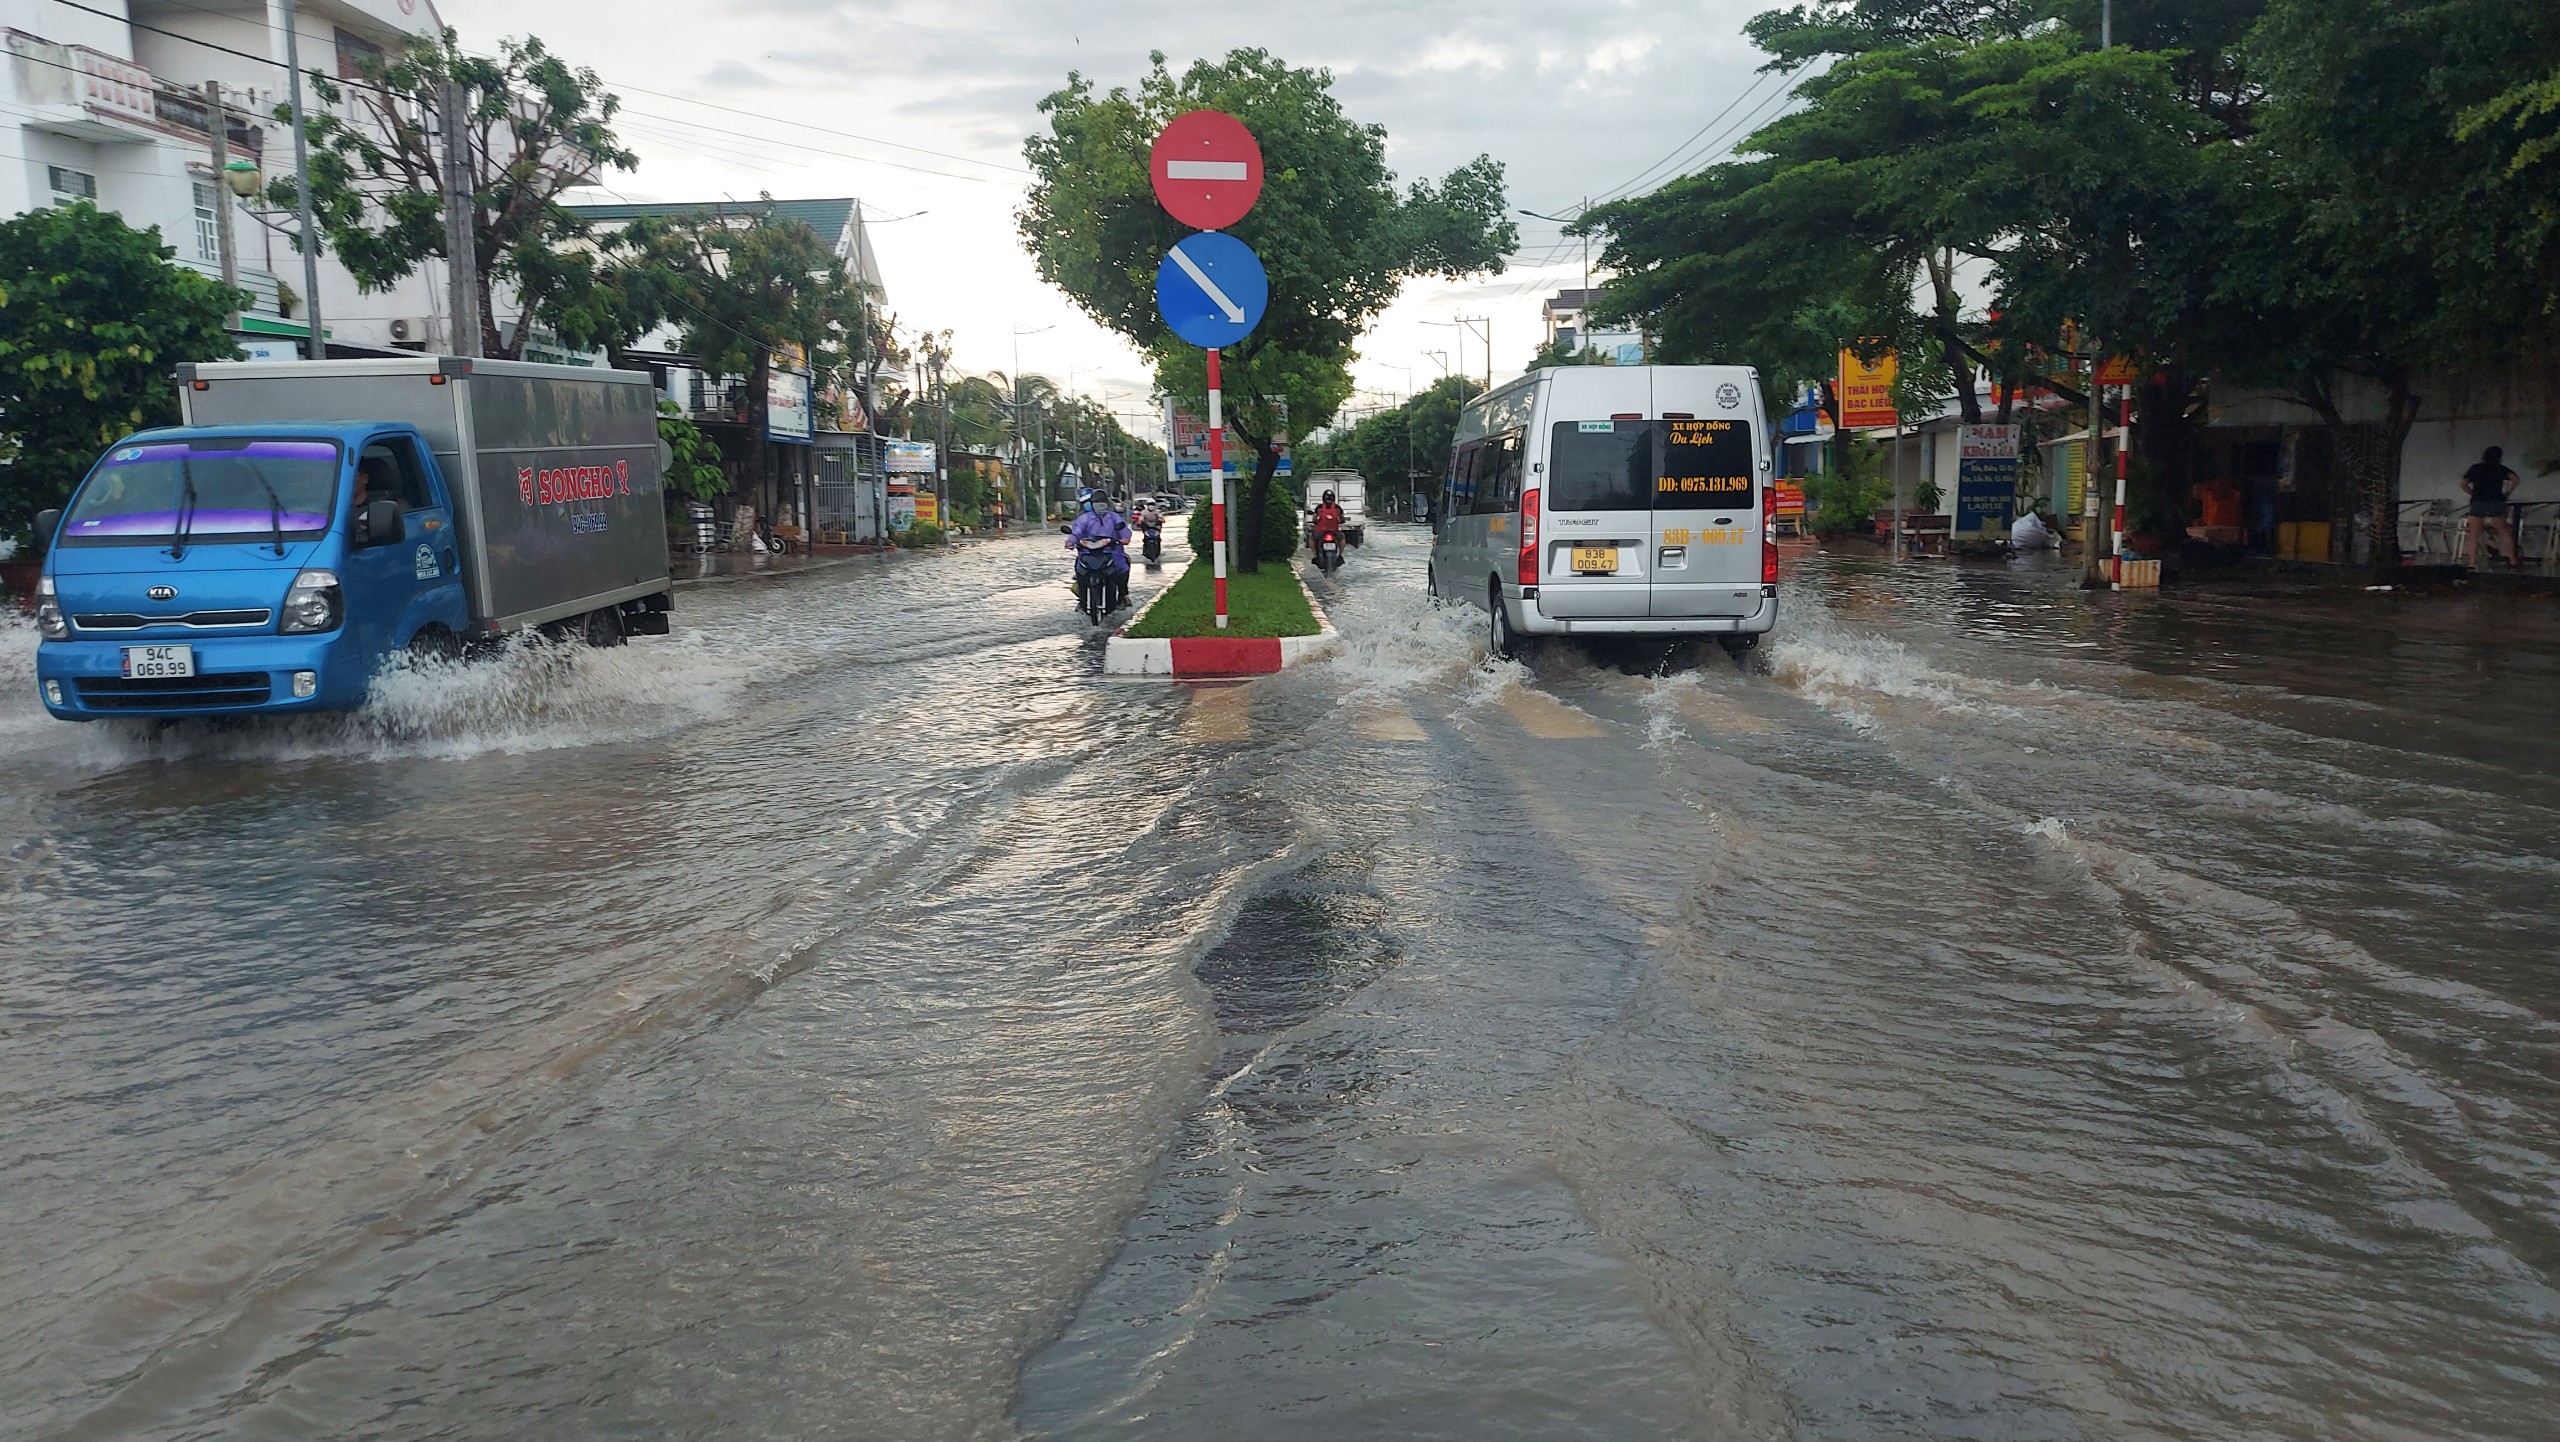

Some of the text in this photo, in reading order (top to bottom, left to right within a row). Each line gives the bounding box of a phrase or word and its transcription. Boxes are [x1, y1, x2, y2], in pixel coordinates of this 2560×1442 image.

[1847, 399, 1867, 410] BẠC
[1672, 422, 1685, 431] XE
[1686, 421, 1705, 432] HỢP
[1670, 431, 1714, 447] Du Lịch
[538, 465, 614, 505] SONGHO
[1680, 476, 1748, 492] 0975.131.969
[1967, 502, 2005, 510] LARUE
[1664, 528, 1690, 545] 83B
[1702, 527, 1745, 545] 009.47
[1585, 549, 1605, 559] 83B
[1577, 559, 1613, 570] 009.47
[149, 588, 172, 597] KIA
[146, 647, 174, 661] 94C
[136, 661, 187, 676] 069.99
